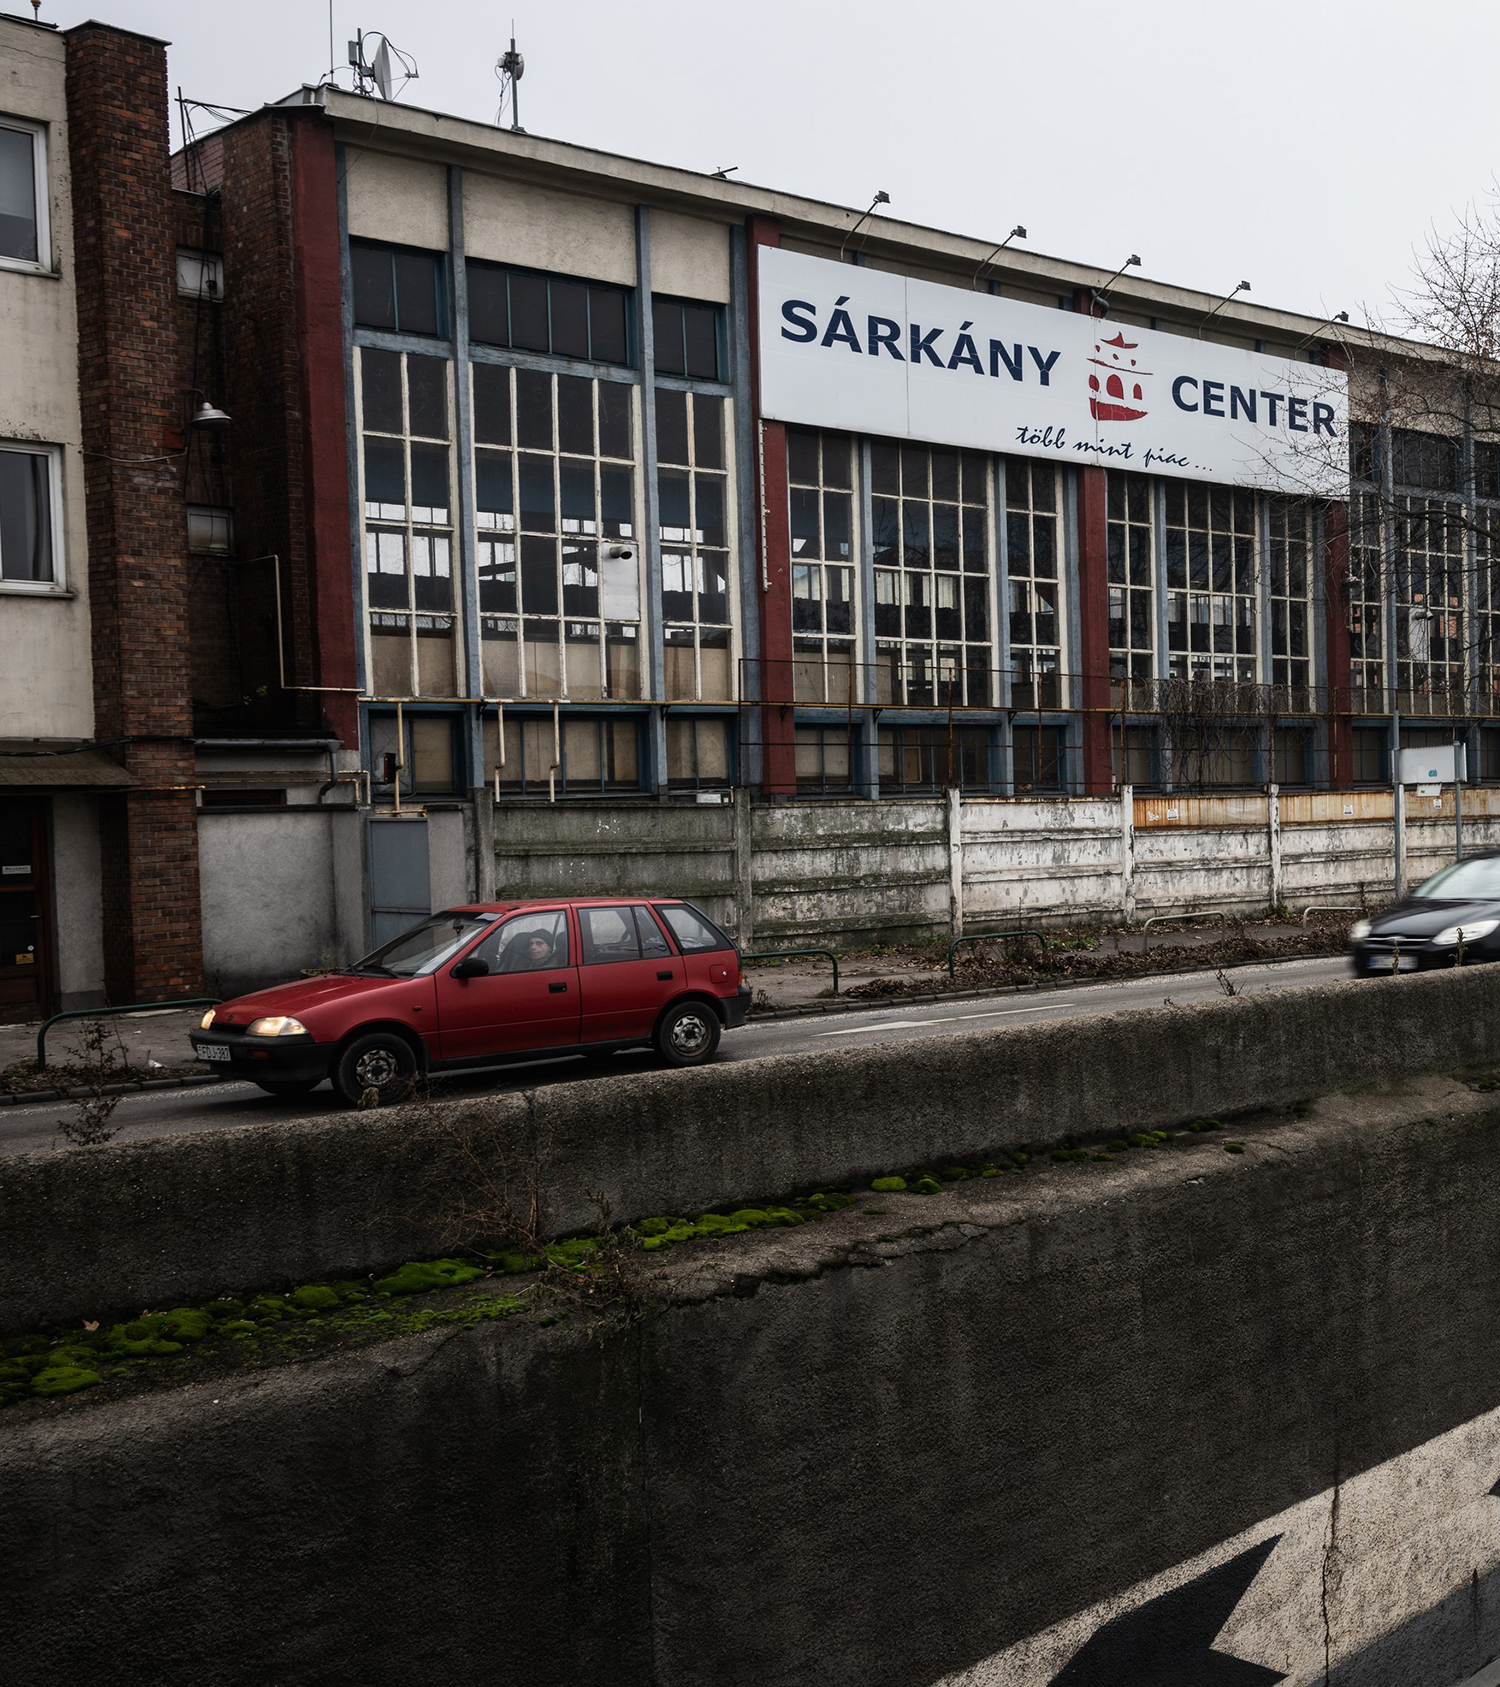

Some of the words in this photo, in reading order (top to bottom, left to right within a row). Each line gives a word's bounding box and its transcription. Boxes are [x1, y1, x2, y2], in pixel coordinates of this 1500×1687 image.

[780, 295, 1061, 387] SÁRKÁNY
[1171, 375, 1338, 438] CENTER
[1015, 425, 1067, 450] több
[1072, 437, 1135, 460] mint
